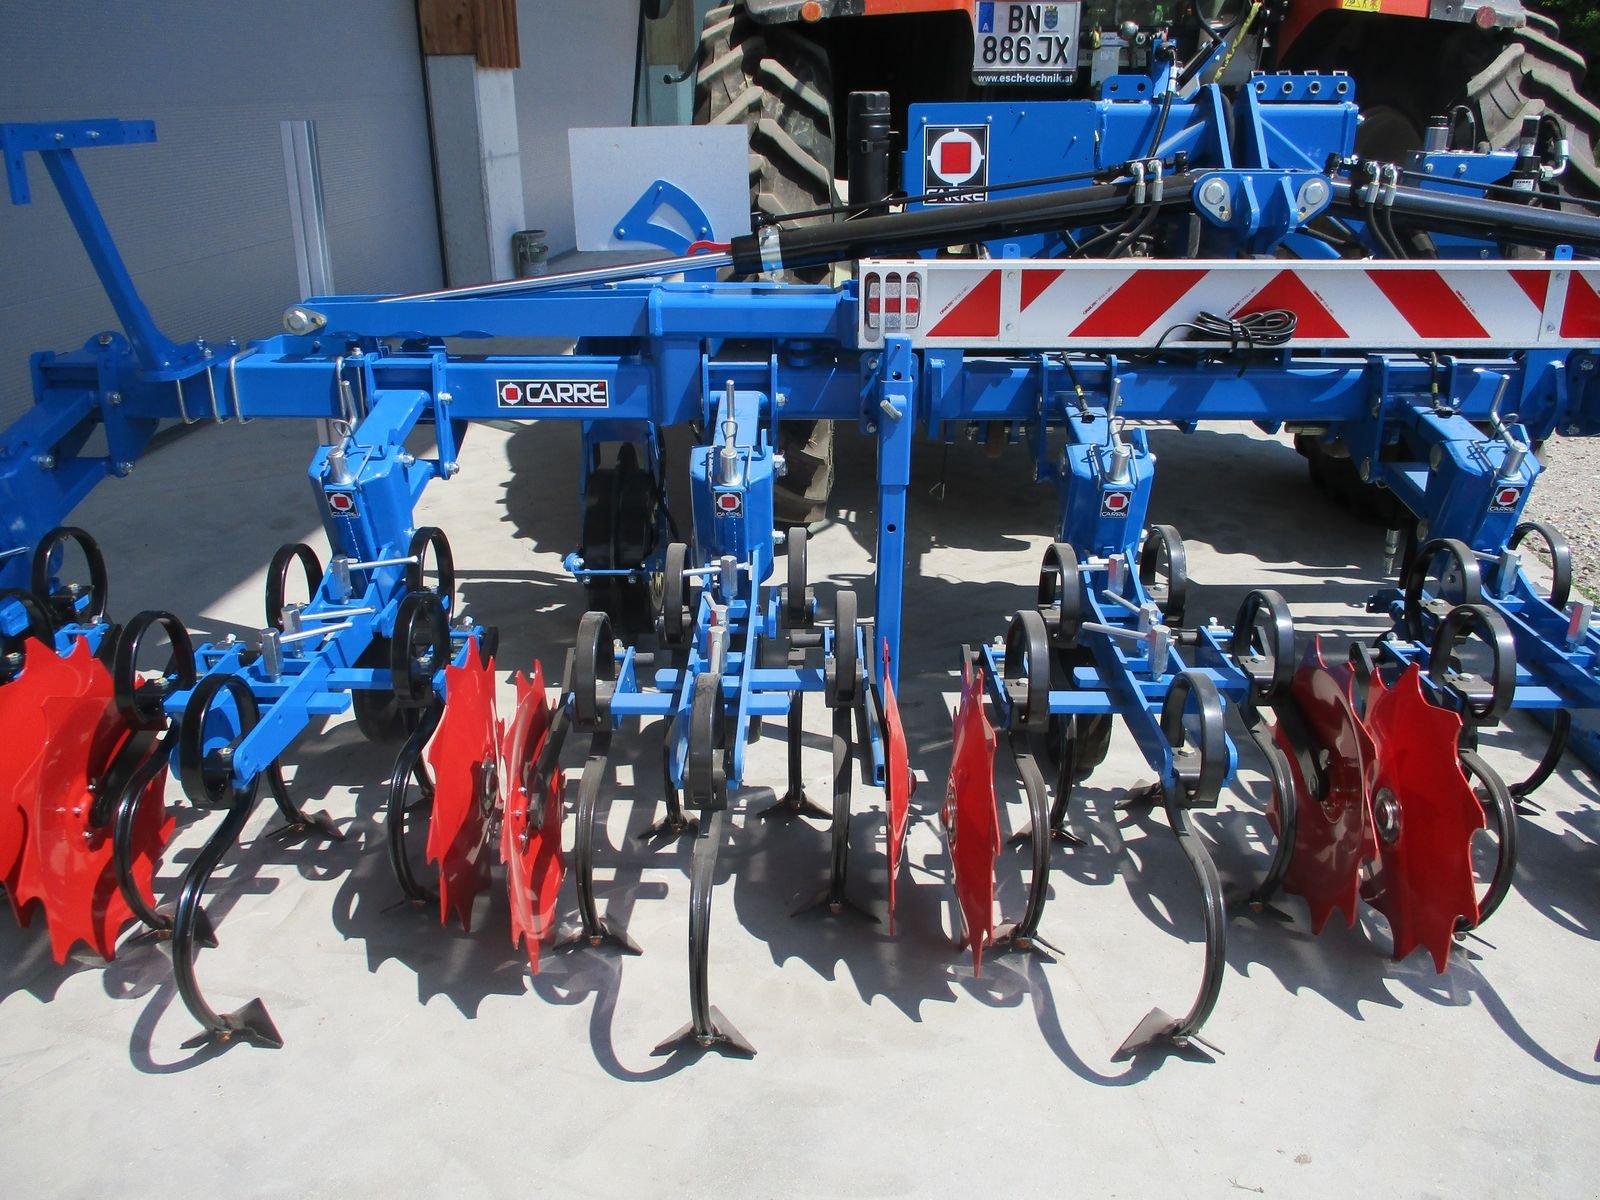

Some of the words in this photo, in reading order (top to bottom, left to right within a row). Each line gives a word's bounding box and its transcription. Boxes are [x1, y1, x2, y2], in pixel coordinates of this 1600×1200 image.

[982, 22, 990, 32] A
[1008, 5, 1041, 33] BN
[983, 36, 1031, 64] 886
[1037, 36, 1070, 64] JX
[978, 73, 1073, 83] www.esch-technik.at
